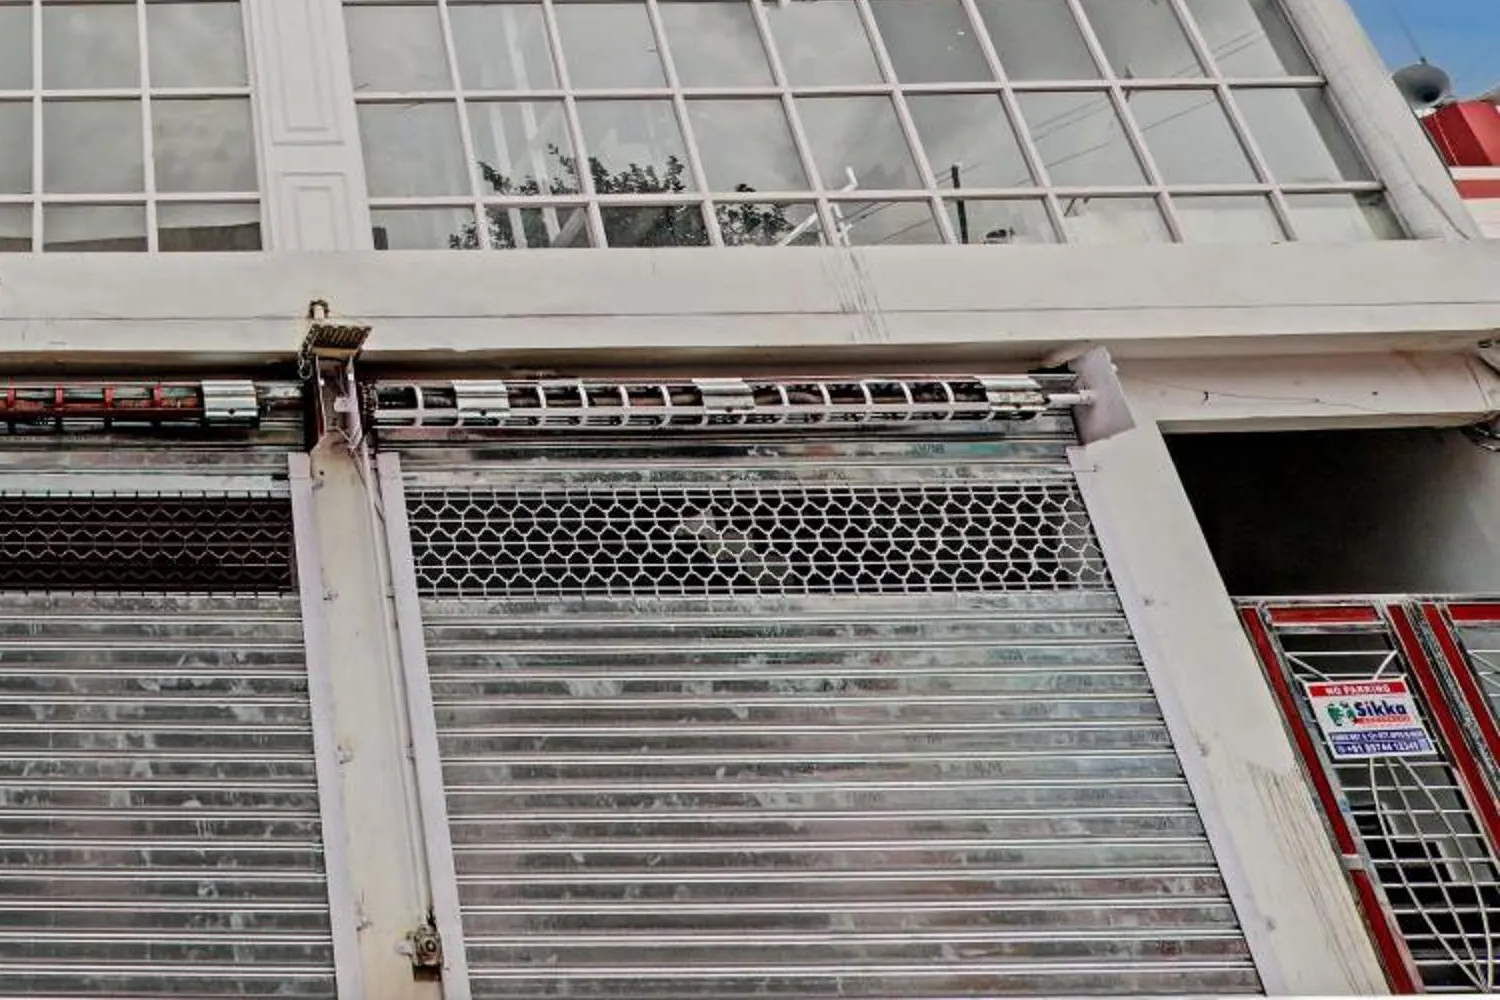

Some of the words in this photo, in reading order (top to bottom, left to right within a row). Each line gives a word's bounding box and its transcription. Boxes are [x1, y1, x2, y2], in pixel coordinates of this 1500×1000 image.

[1325, 686, 1342, 696] NO
[1343, 683, 1391, 695] PARKING
[1353, 700, 1407, 717] Sikka
